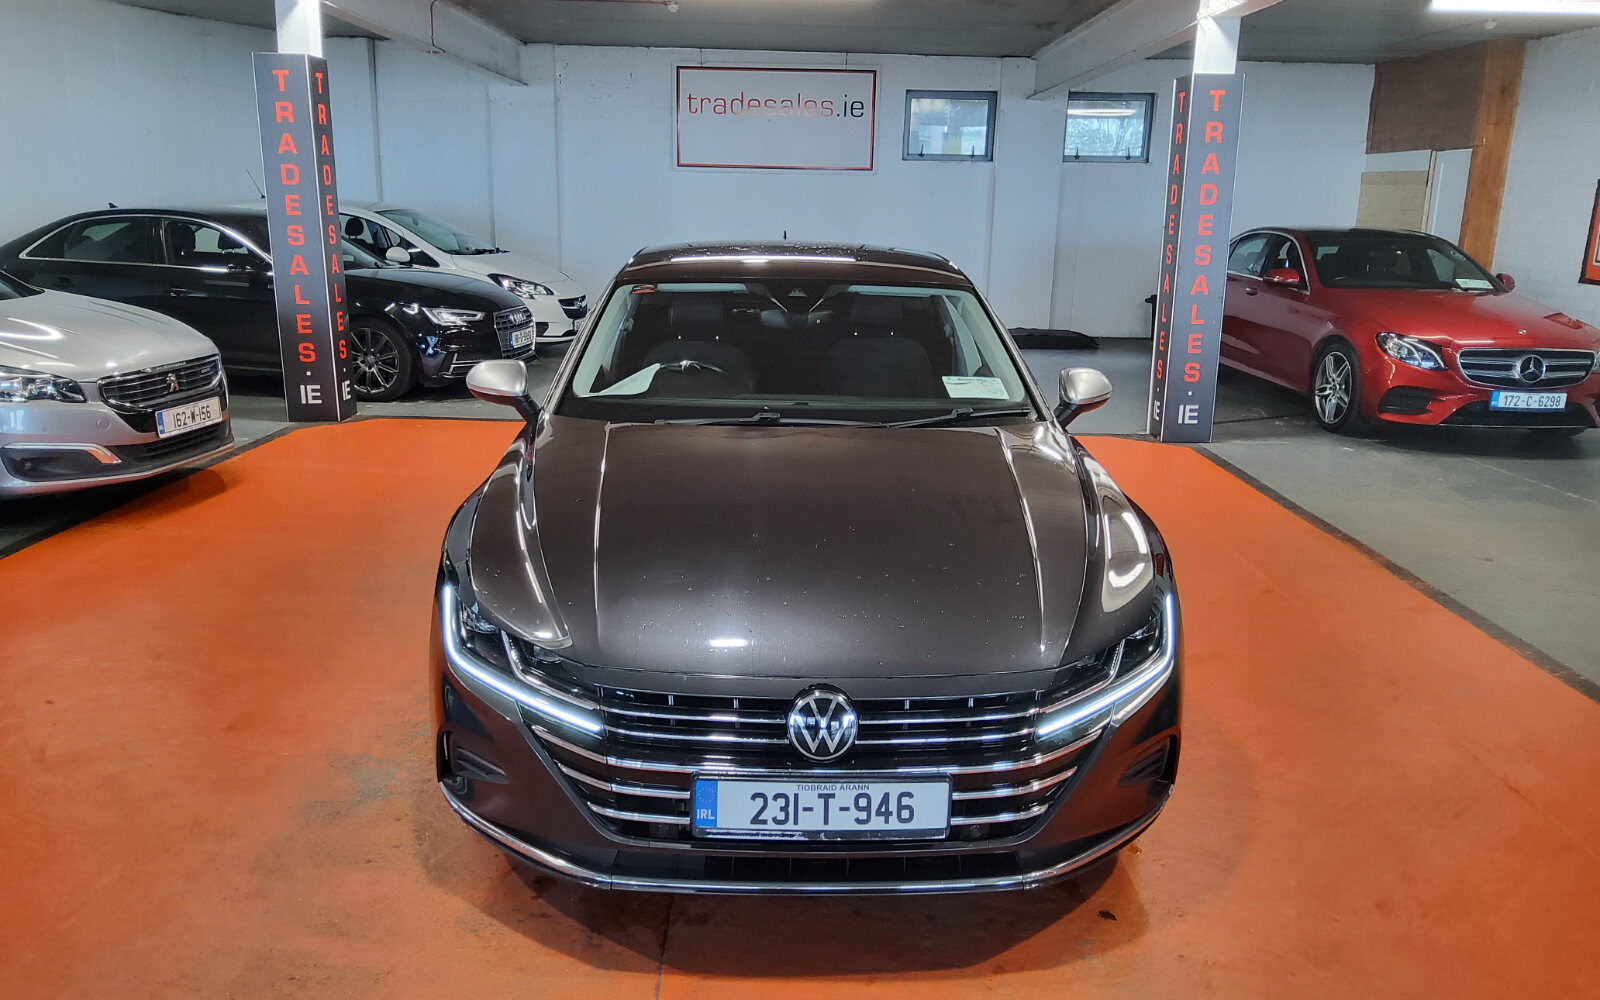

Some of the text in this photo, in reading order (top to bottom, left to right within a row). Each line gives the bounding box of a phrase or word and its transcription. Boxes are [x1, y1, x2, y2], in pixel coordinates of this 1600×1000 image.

[686, 91, 865, 118] tradesales.ie
[1503, 395, 1561, 408] 172-C-6298
[172, 404, 212, 429] 162-W-156
[796, 784, 837, 792] TIOBRAID
[696, 792, 915, 826] IRL 231-T-946
